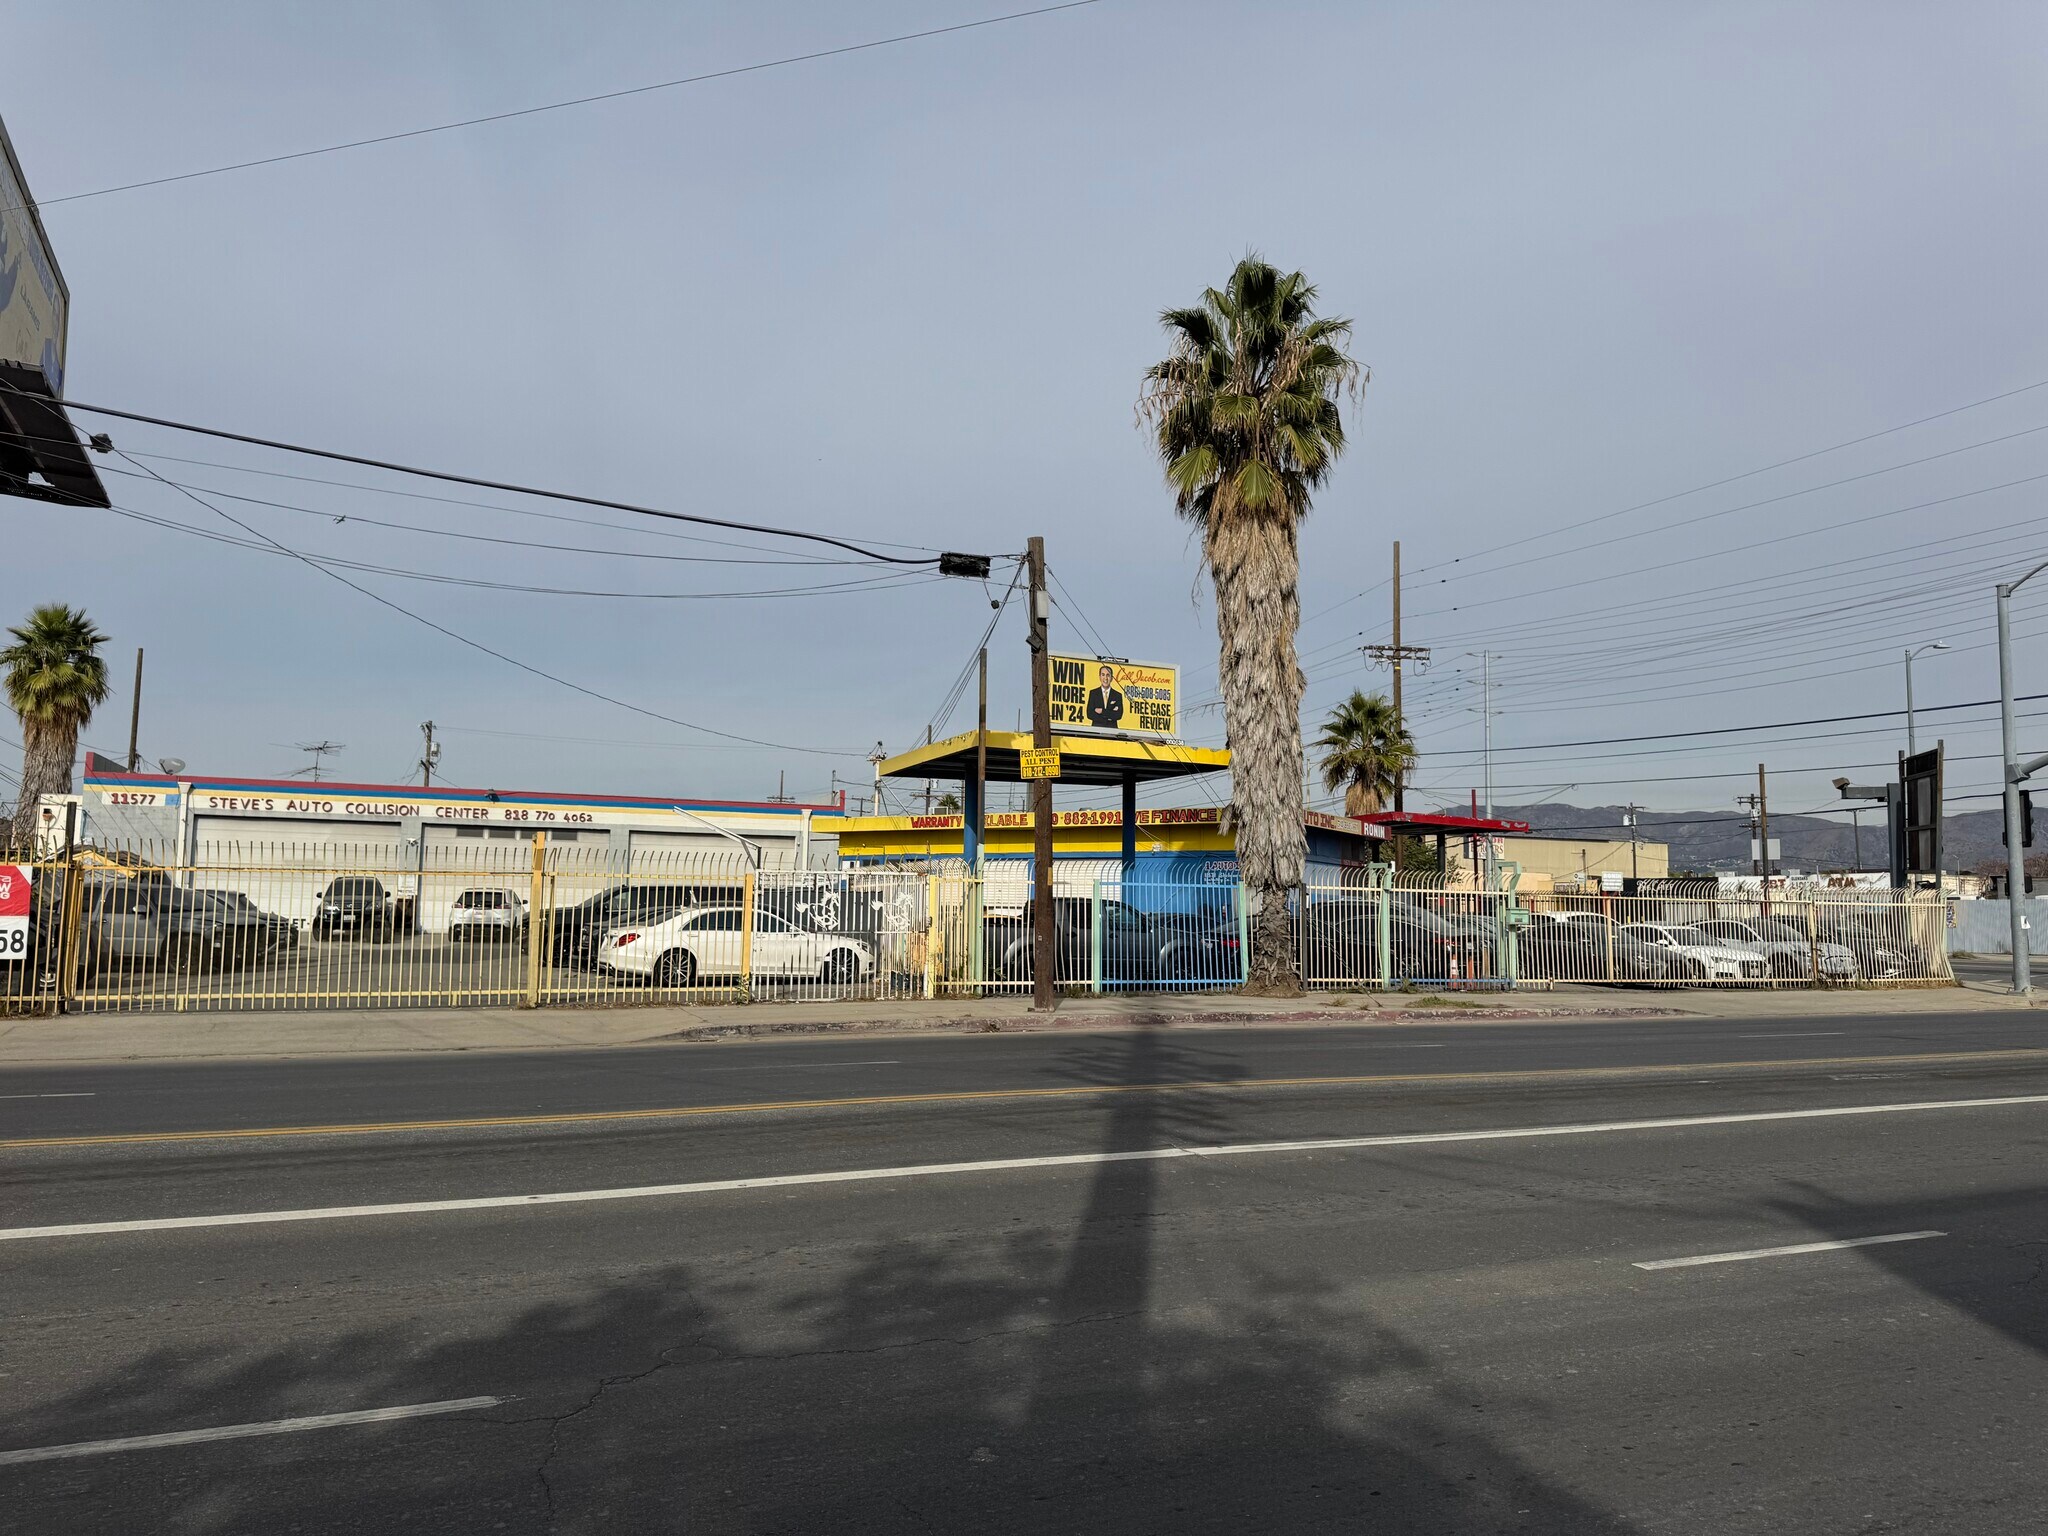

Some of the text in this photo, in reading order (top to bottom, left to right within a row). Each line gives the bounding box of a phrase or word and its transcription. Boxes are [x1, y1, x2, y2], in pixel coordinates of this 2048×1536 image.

[1053, 660, 1085, 685] WIN
[1052, 684, 1086, 704] MORE
[1051, 703, 1084, 723] IN '24
[1130, 701, 1171, 717] FREE CASE
[1140, 716, 1171, 731] REVIEW
[1021, 748, 1059, 758] PEST CONTROL
[1040, 757, 1056, 765] PEST
[111, 792, 156, 805] 11577
[209, 797, 593, 823] STEVE'S AUTO COLLISION CENTER 818 770 4062
[1303, 810, 1319, 826] UTO
[911, 815, 963, 829] WARRANTY
[984, 813, 1028, 826] ILABLE
[1151, 808, 1217, 823] FINANCE
[1363, 822, 1385, 838] RONIN
[1827, 876, 1856, 888] ATM
